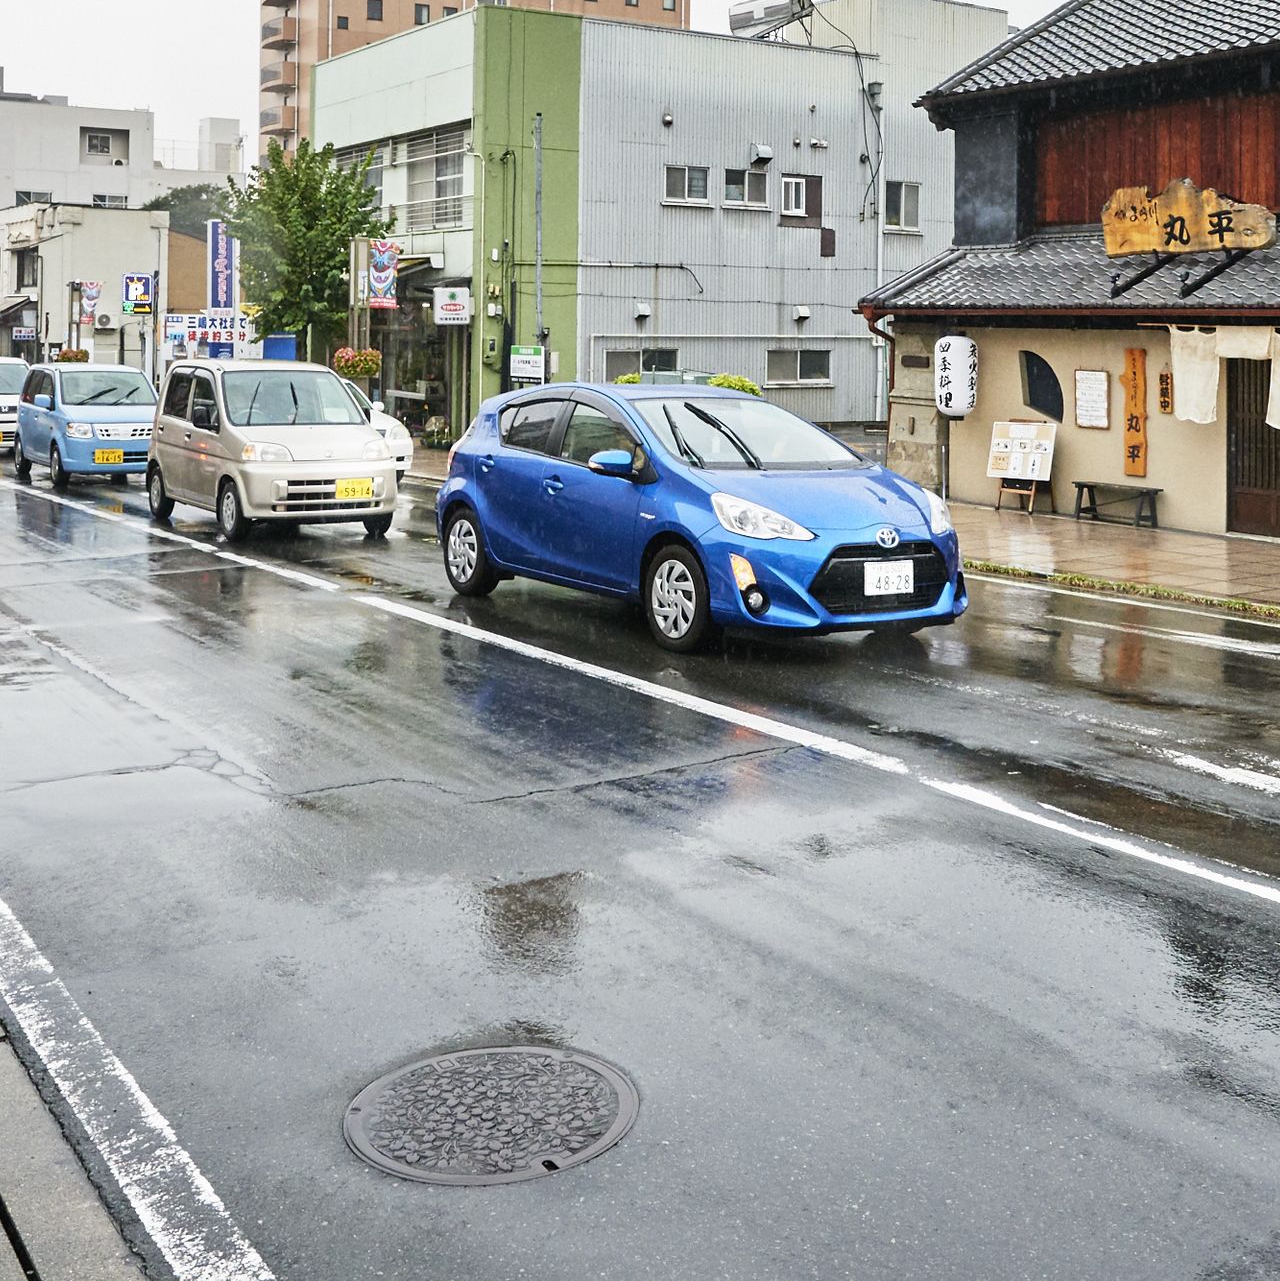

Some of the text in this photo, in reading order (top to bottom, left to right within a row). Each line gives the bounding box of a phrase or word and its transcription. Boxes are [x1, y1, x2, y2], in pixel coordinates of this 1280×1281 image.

[1163, 209, 1234, 246] 丸平
[938, 341, 953, 408] 四季料理
[1127, 413, 1141, 464] 丸平
[344, 487, 370, 497] 59-14
[875, 574, 910, 591] 48-28
